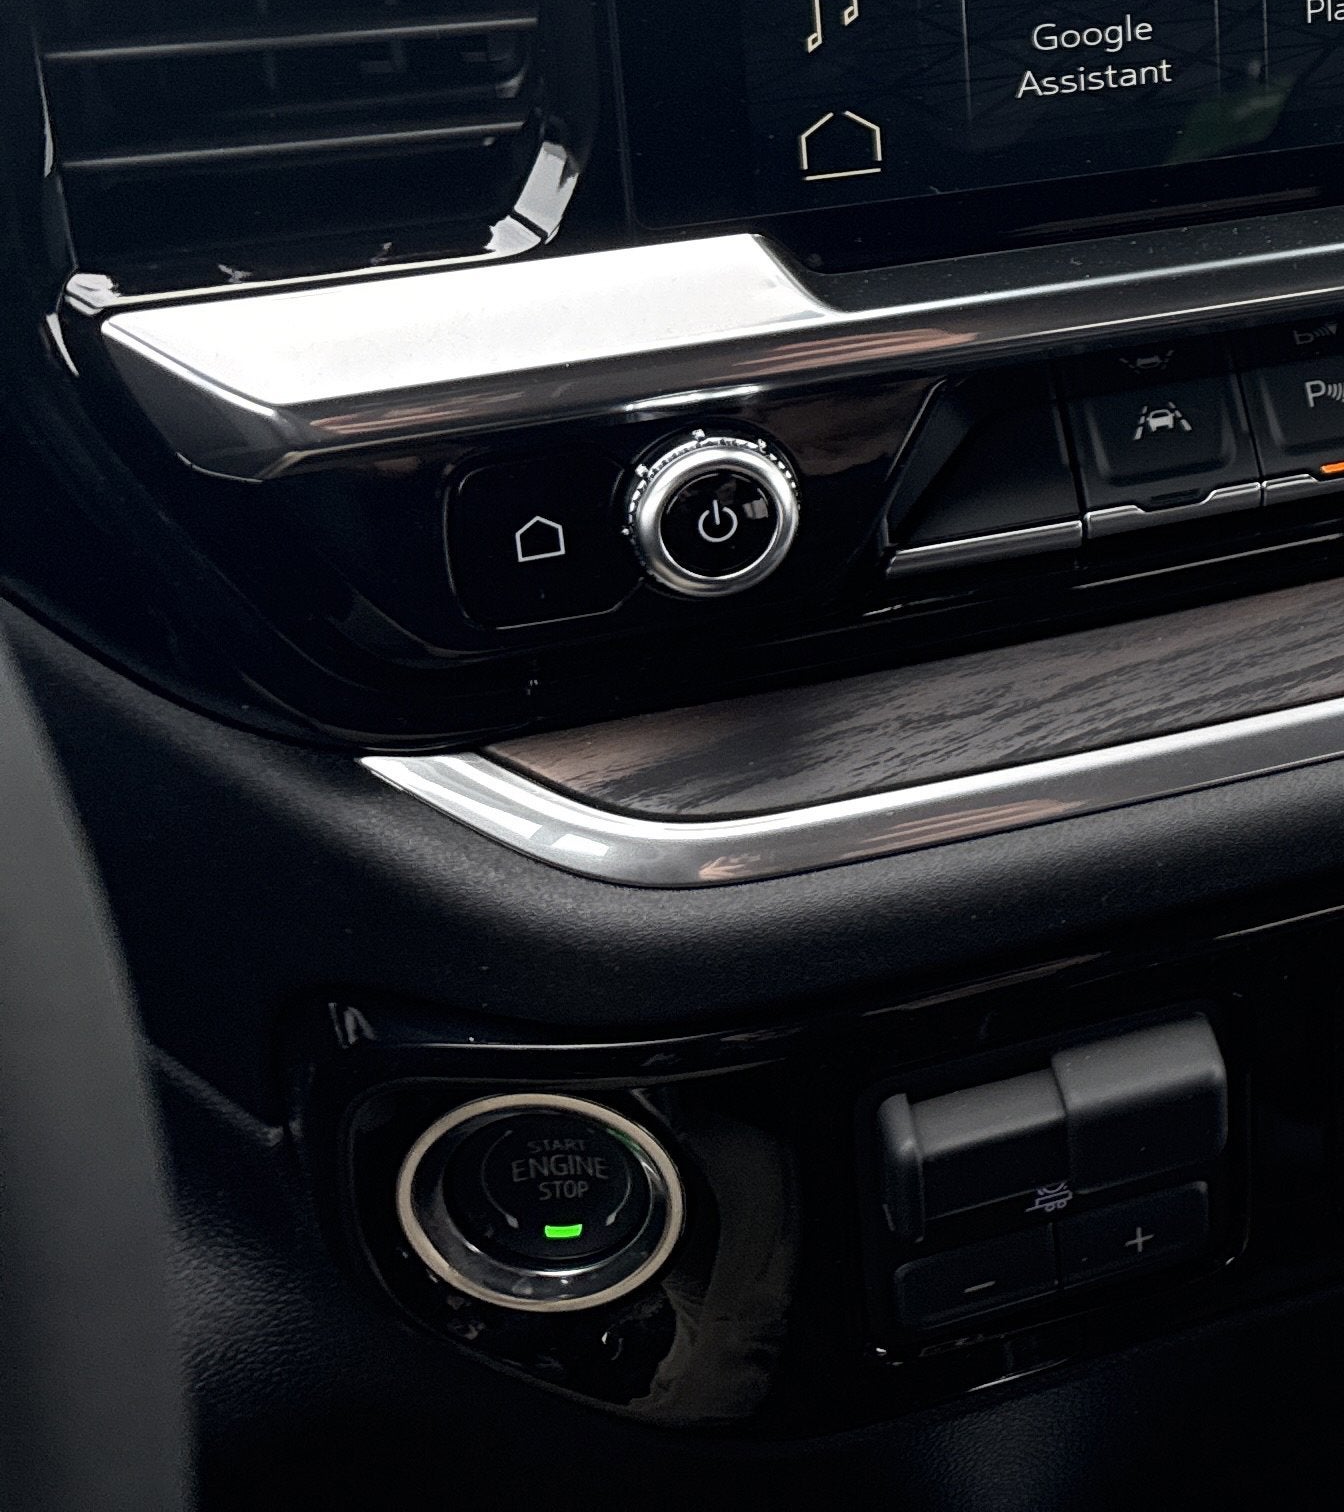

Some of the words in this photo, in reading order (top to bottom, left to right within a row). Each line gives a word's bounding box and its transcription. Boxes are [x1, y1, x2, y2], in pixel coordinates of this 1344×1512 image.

[1032, 13, 1153, 53] Google
[1016, 59, 1172, 99] Assistant
[527, 1138, 585, 1154] START
[511, 1154, 610, 1182] ENGINE
[538, 1180, 589, 1201] STOP
